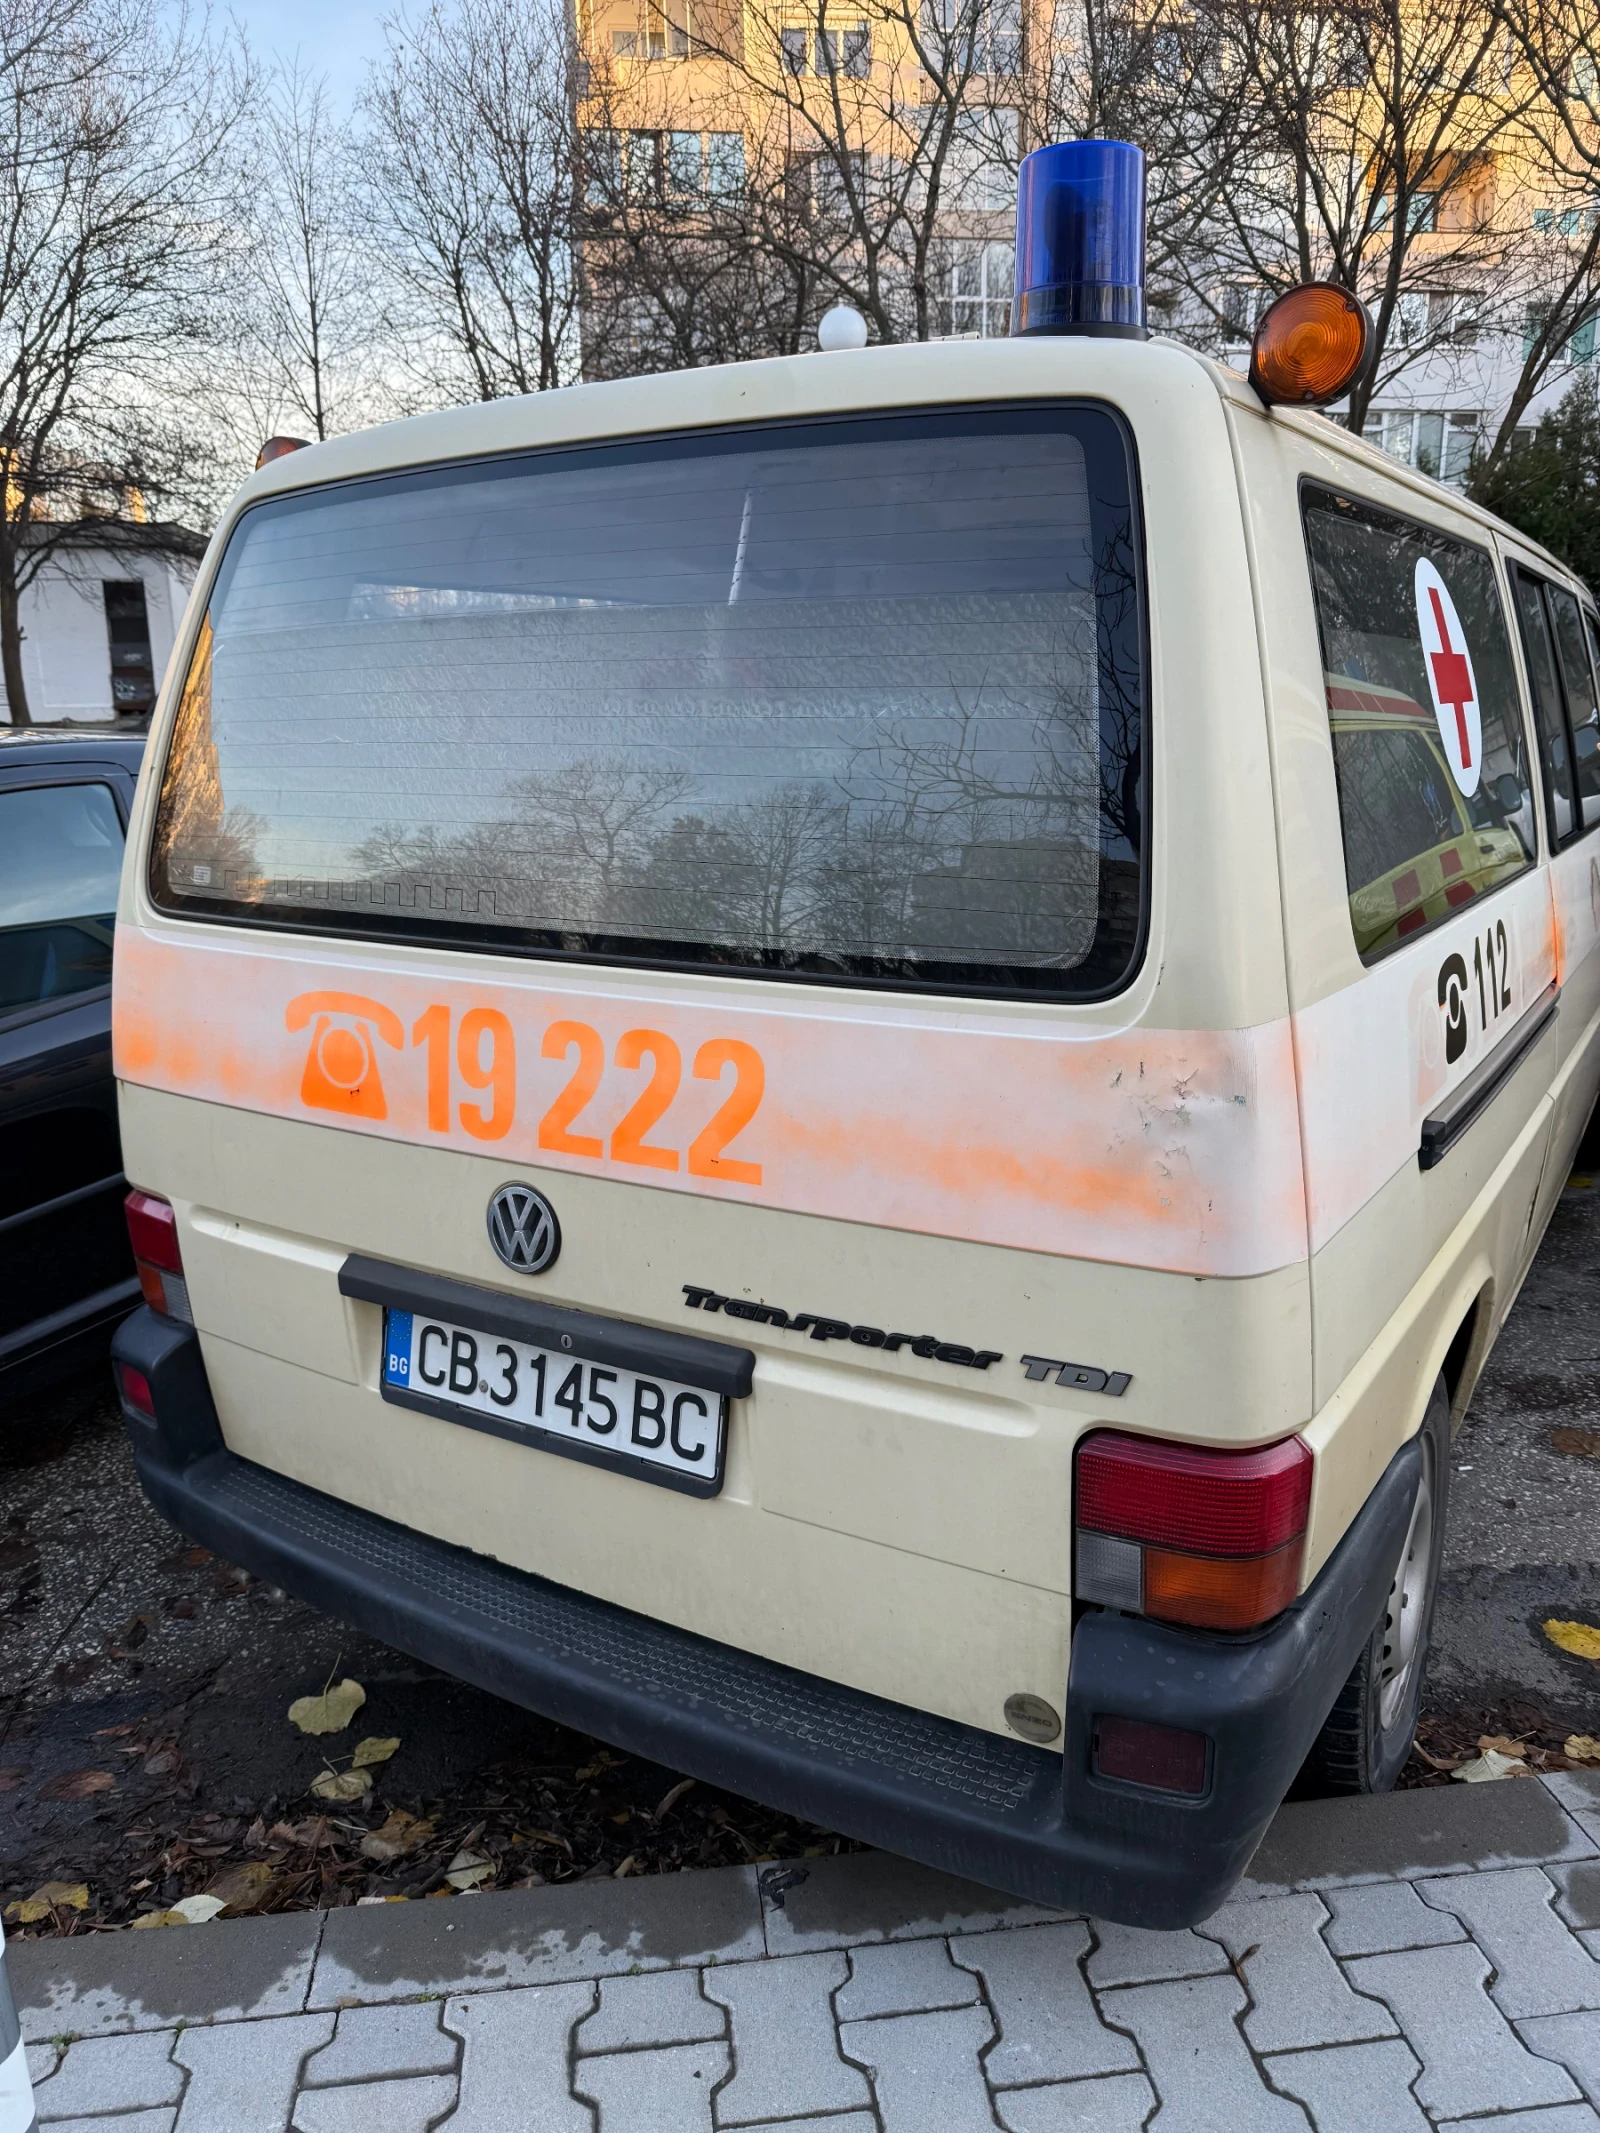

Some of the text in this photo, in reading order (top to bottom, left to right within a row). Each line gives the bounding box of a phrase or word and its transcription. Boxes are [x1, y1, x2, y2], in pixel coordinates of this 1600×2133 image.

[1474, 919, 1511, 1031] 112
[412, 1004, 766, 1186] 19 222
[388, 1353, 409, 1375] BG
[682, 1284, 1133, 1397] Transporter TDI
